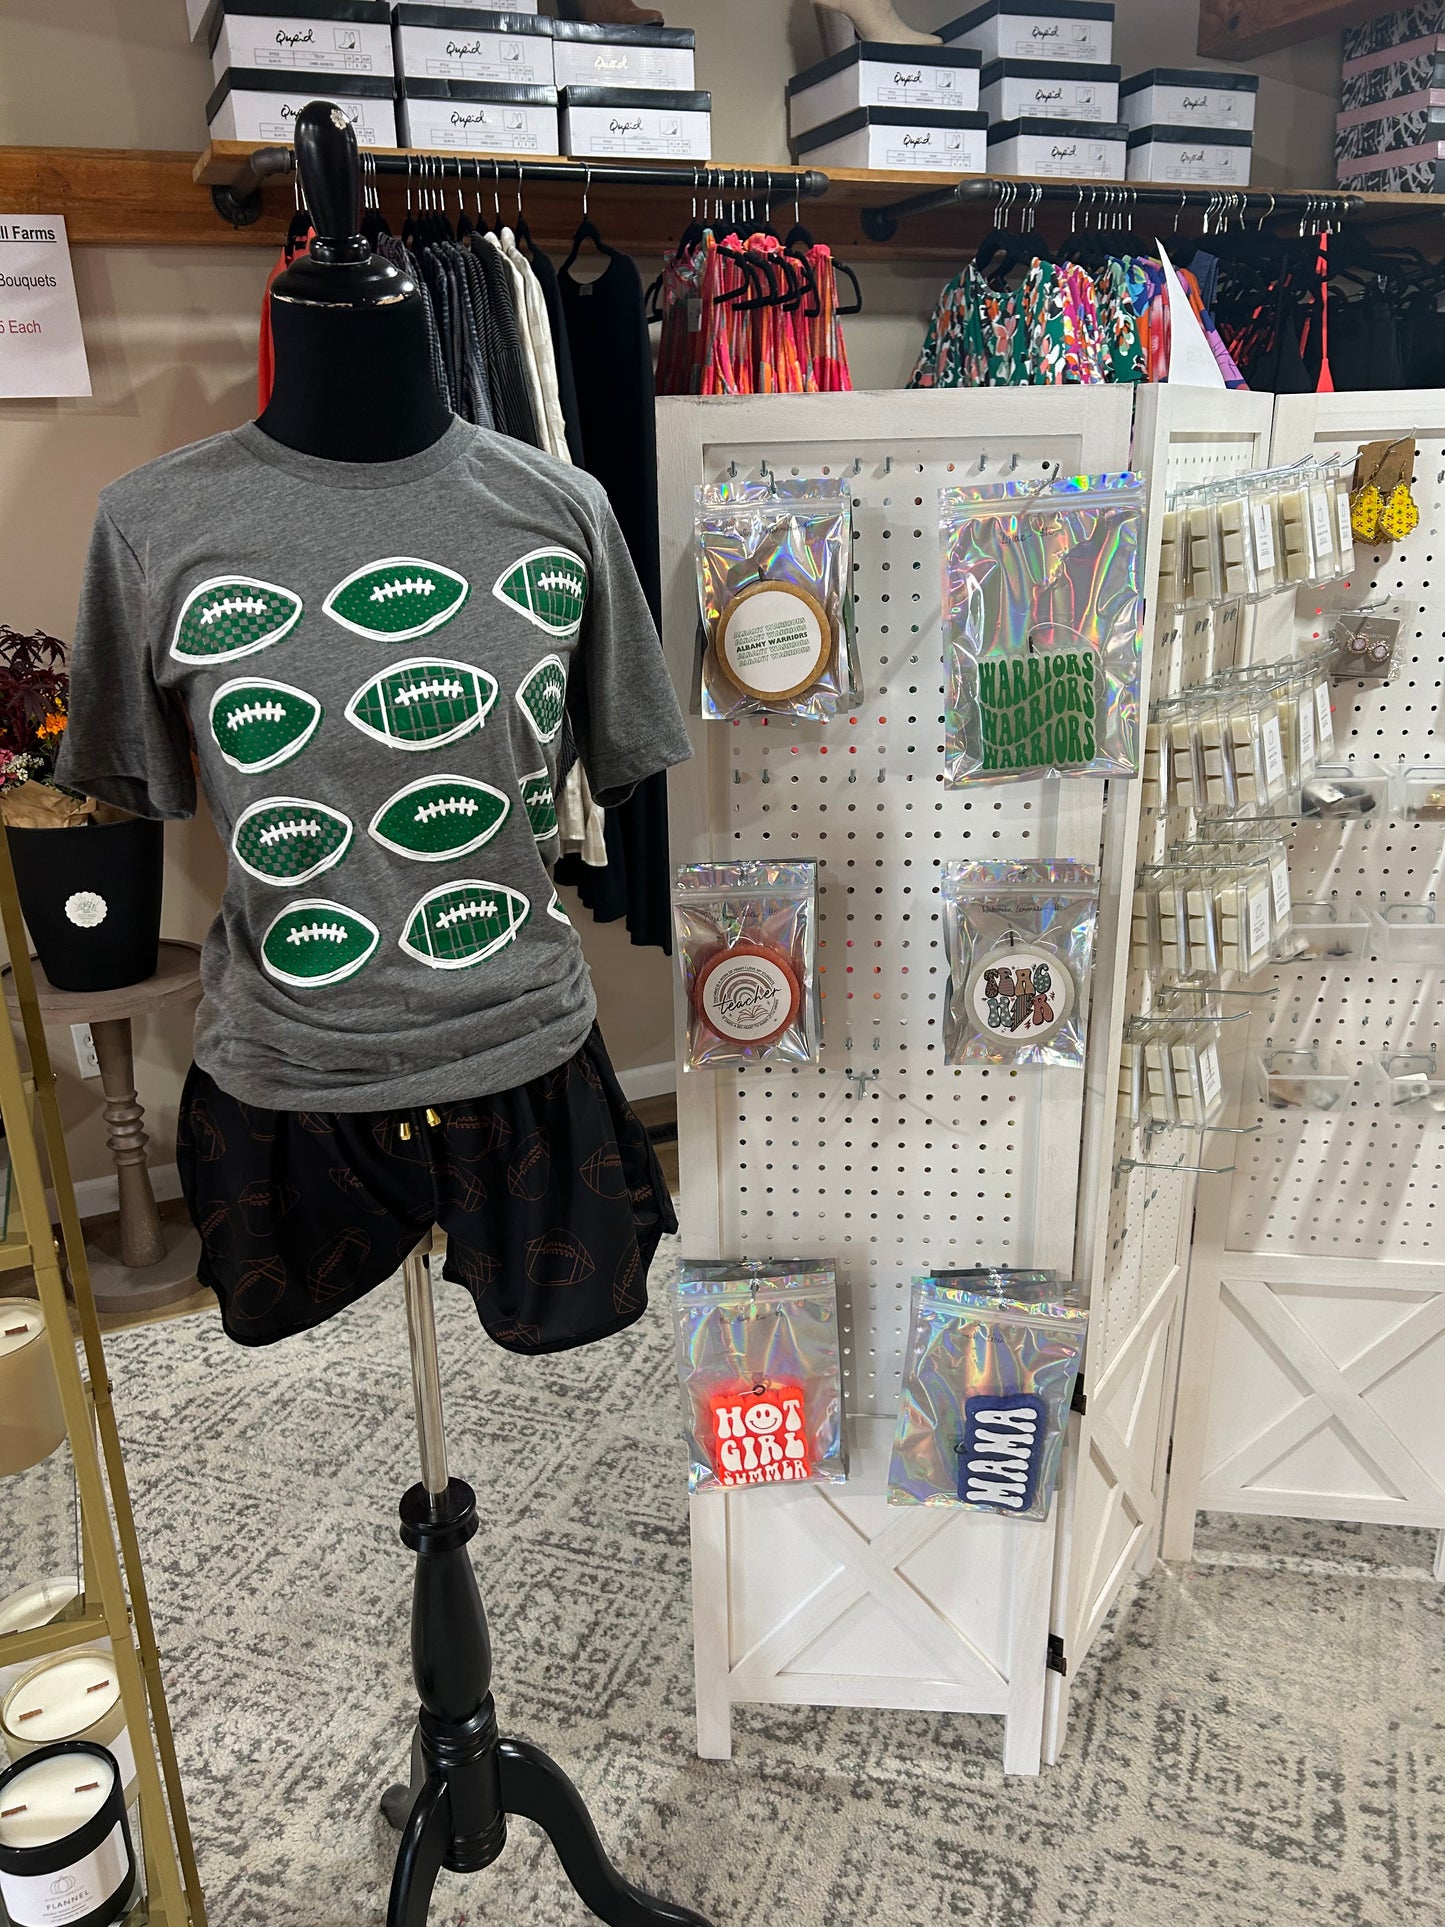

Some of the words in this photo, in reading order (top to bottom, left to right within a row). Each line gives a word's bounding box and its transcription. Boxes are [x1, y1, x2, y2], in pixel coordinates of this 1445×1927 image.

[275, 29, 316, 46] Qupid
[446, 40, 482, 58] Qupid
[451, 110, 486, 128] Qupid
[610, 117, 644, 134] Qupid
[0, 226, 8, 239] ll
[12, 226, 56, 240] Farms
[0, 273, 57, 290] Bouquets
[9, 320, 42, 334] Each
[736, 641, 766, 652] ALBANY
[768, 632, 808, 645] WARRIORS
[978, 652, 1094, 709] WARRIORS
[980, 676, 1095, 746] WARRIORS
[982, 715, 1096, 770] WARRIORS
[713, 985, 782, 1014] teacher
[720, 1432, 804, 1472] GIRL
[966, 1408, 1038, 1508] MAMA
[724, 1460, 808, 1486] SUMMER
[46, 1890, 89, 1910] FLANNEL
